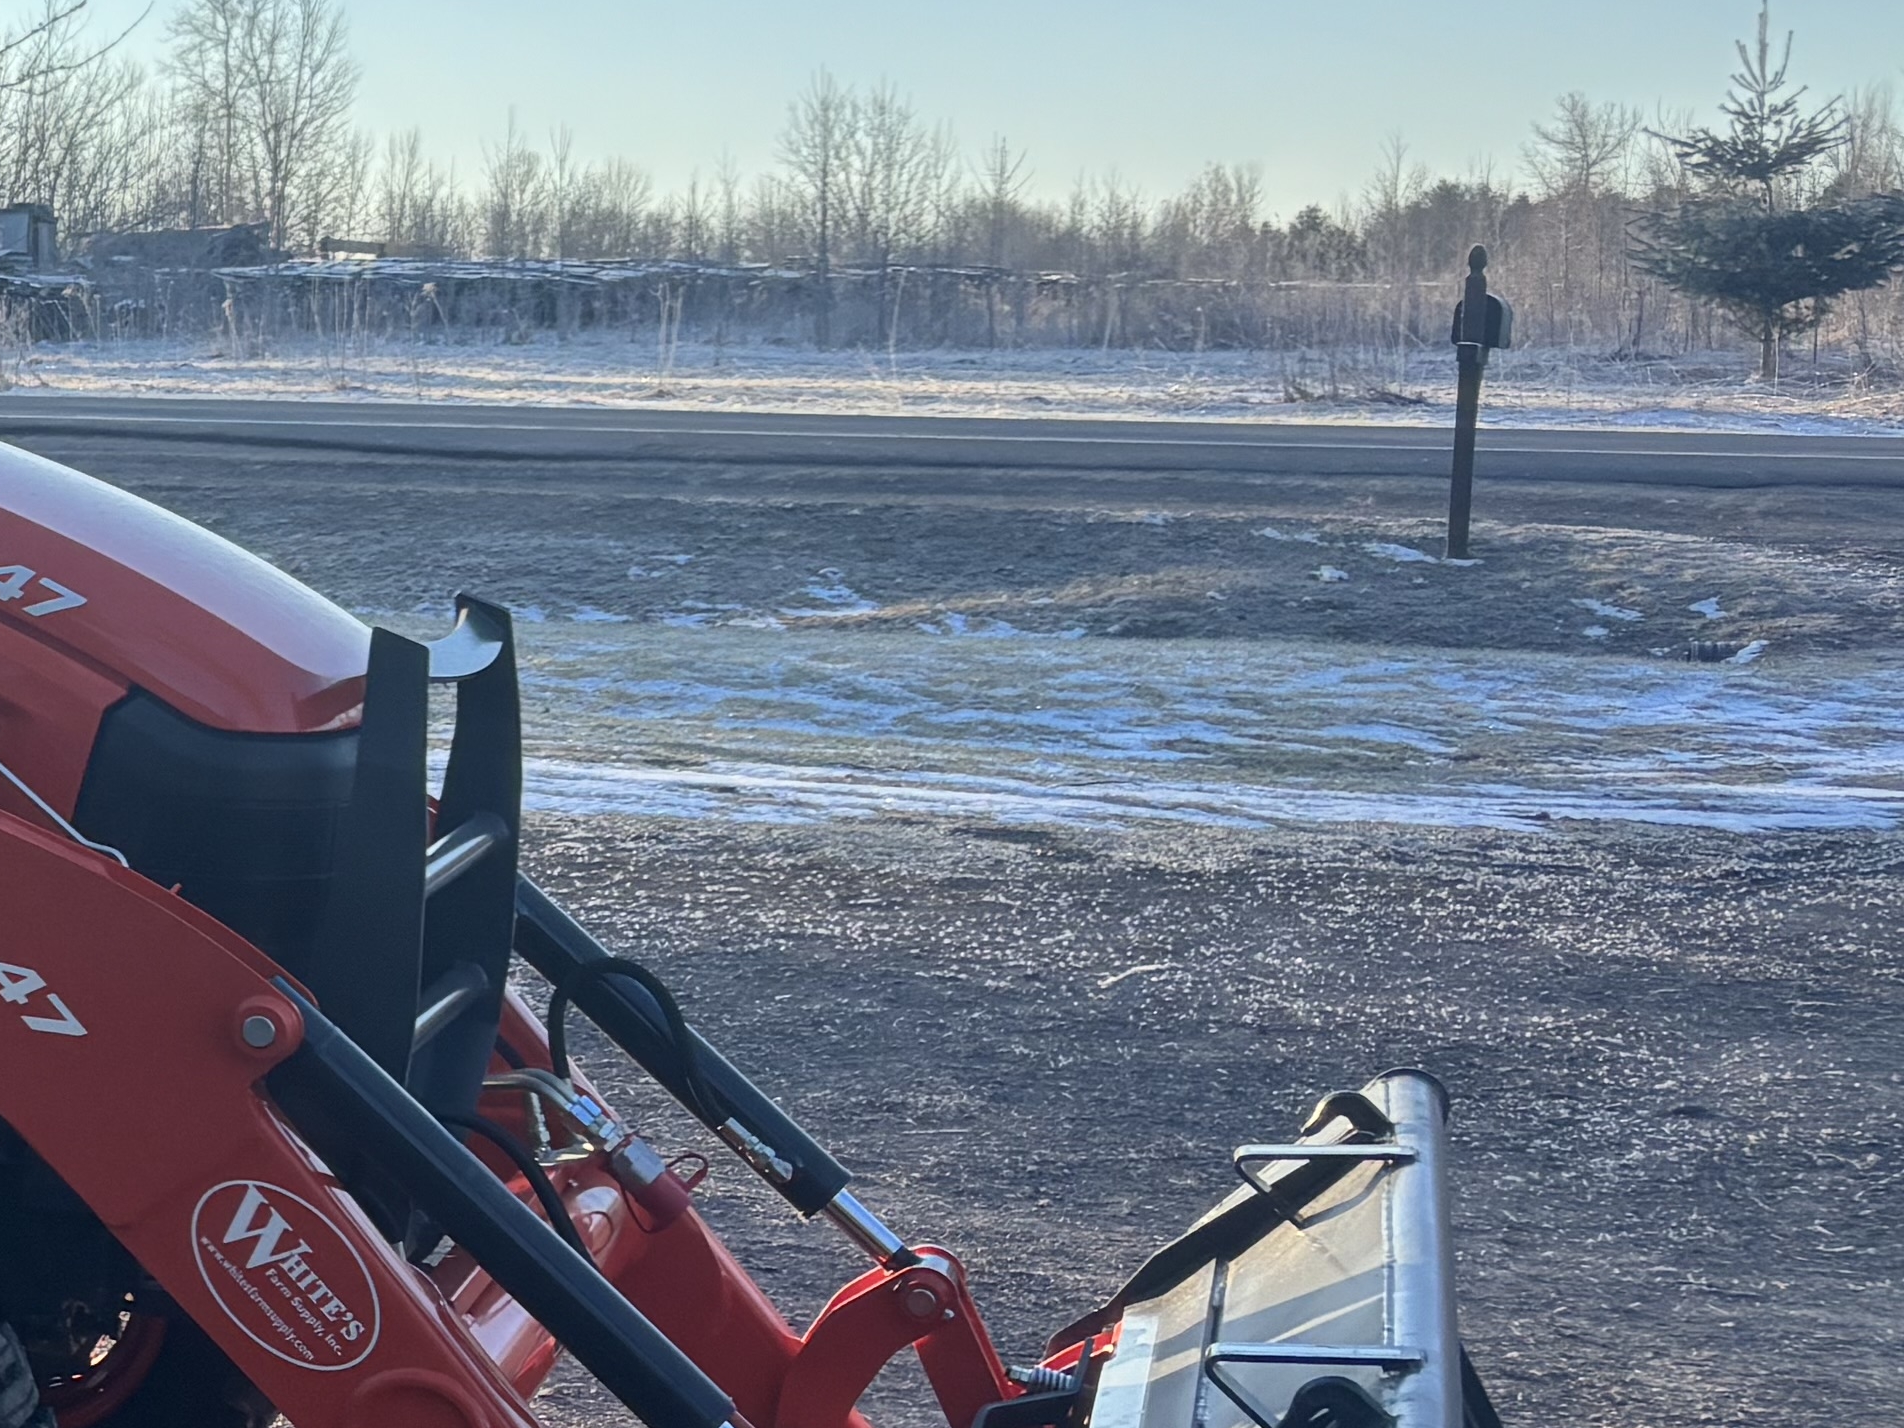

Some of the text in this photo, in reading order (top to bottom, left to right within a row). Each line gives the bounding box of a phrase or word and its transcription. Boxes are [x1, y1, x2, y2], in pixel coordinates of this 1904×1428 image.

[200, 1236, 314, 1360] www.whitesfarmsupply.com
[223, 1183, 365, 1341] WHITE'S
[265, 1268, 342, 1356] Farm Supply, Inc.
